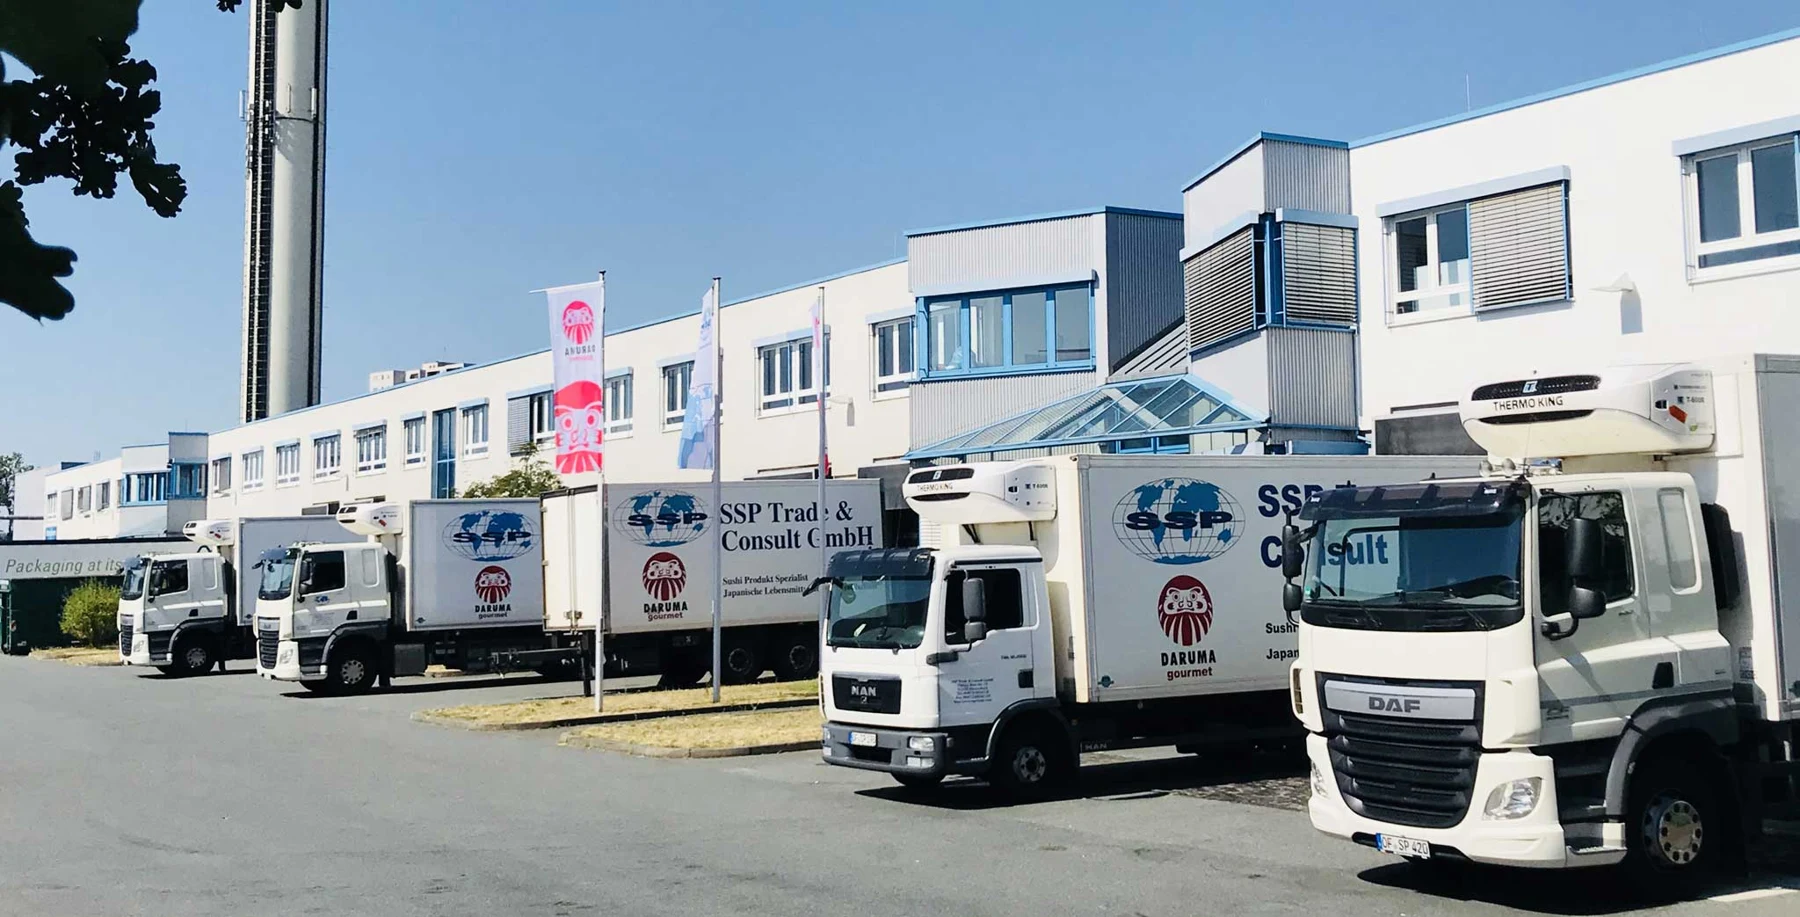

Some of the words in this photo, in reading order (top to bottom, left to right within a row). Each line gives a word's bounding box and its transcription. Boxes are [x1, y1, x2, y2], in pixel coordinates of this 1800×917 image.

[1494, 400, 1535, 411] THERMO
[1538, 396, 1564, 407] KING
[720, 502, 762, 524] SSP
[836, 500, 853, 521] &
[627, 512, 708, 527] SSP
[1126, 511, 1233, 531] SSP
[453, 531, 532, 543] SSP
[721, 528, 800, 551] Consult
[6, 559, 82, 575] Packaging
[88, 560, 102, 572] at
[106, 559, 122, 572] its
[722, 577, 743, 585] Sushi
[744, 575, 773, 584] Produkt
[775, 574, 808, 584] Spezialist
[723, 587, 763, 598] Japanische
[475, 604, 512, 613] DARUMA
[644, 601, 688, 613] DARUMA
[478, 612, 508, 620] gourmet
[648, 612, 683, 622] gourmet
[1161, 649, 1216, 667] DARUMA
[1167, 667, 1213, 681] gourmet
[851, 685, 877, 697] MAN
[1369, 696, 1420, 713] DAF
[1398, 839, 1410, 851] SP
[1412, 841, 1428, 854] 420
